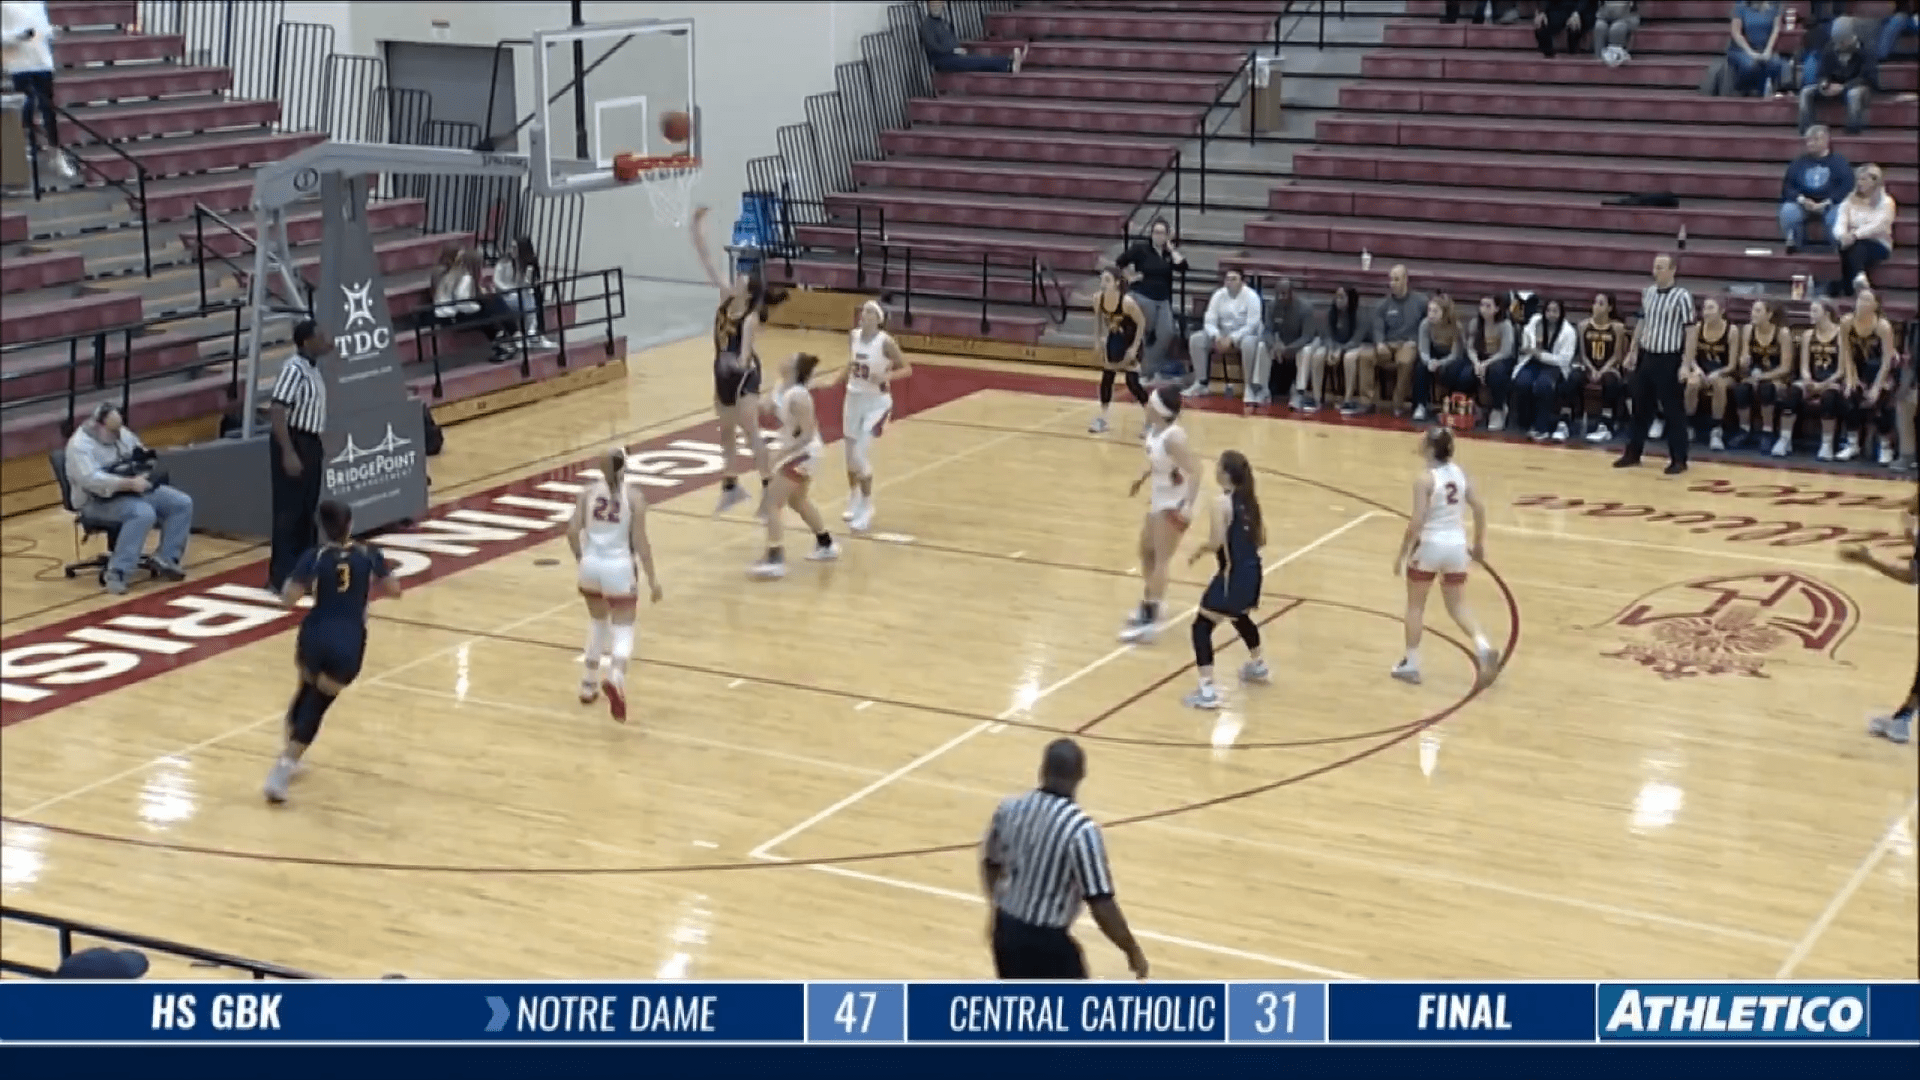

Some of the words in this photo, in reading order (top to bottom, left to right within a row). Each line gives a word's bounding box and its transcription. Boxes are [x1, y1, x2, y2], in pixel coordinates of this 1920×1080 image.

[334, 327, 390, 359] TDC
[1592, 341, 1606, 360] 10
[326, 450, 416, 490] BRIDGEPOINT
[379, 424, 785, 578] IGHTIN
[1445, 482, 1459, 505] 2
[593, 496, 621, 523] 22
[336, 563, 350, 592] 3
[2, 583, 315, 703] IRIS
